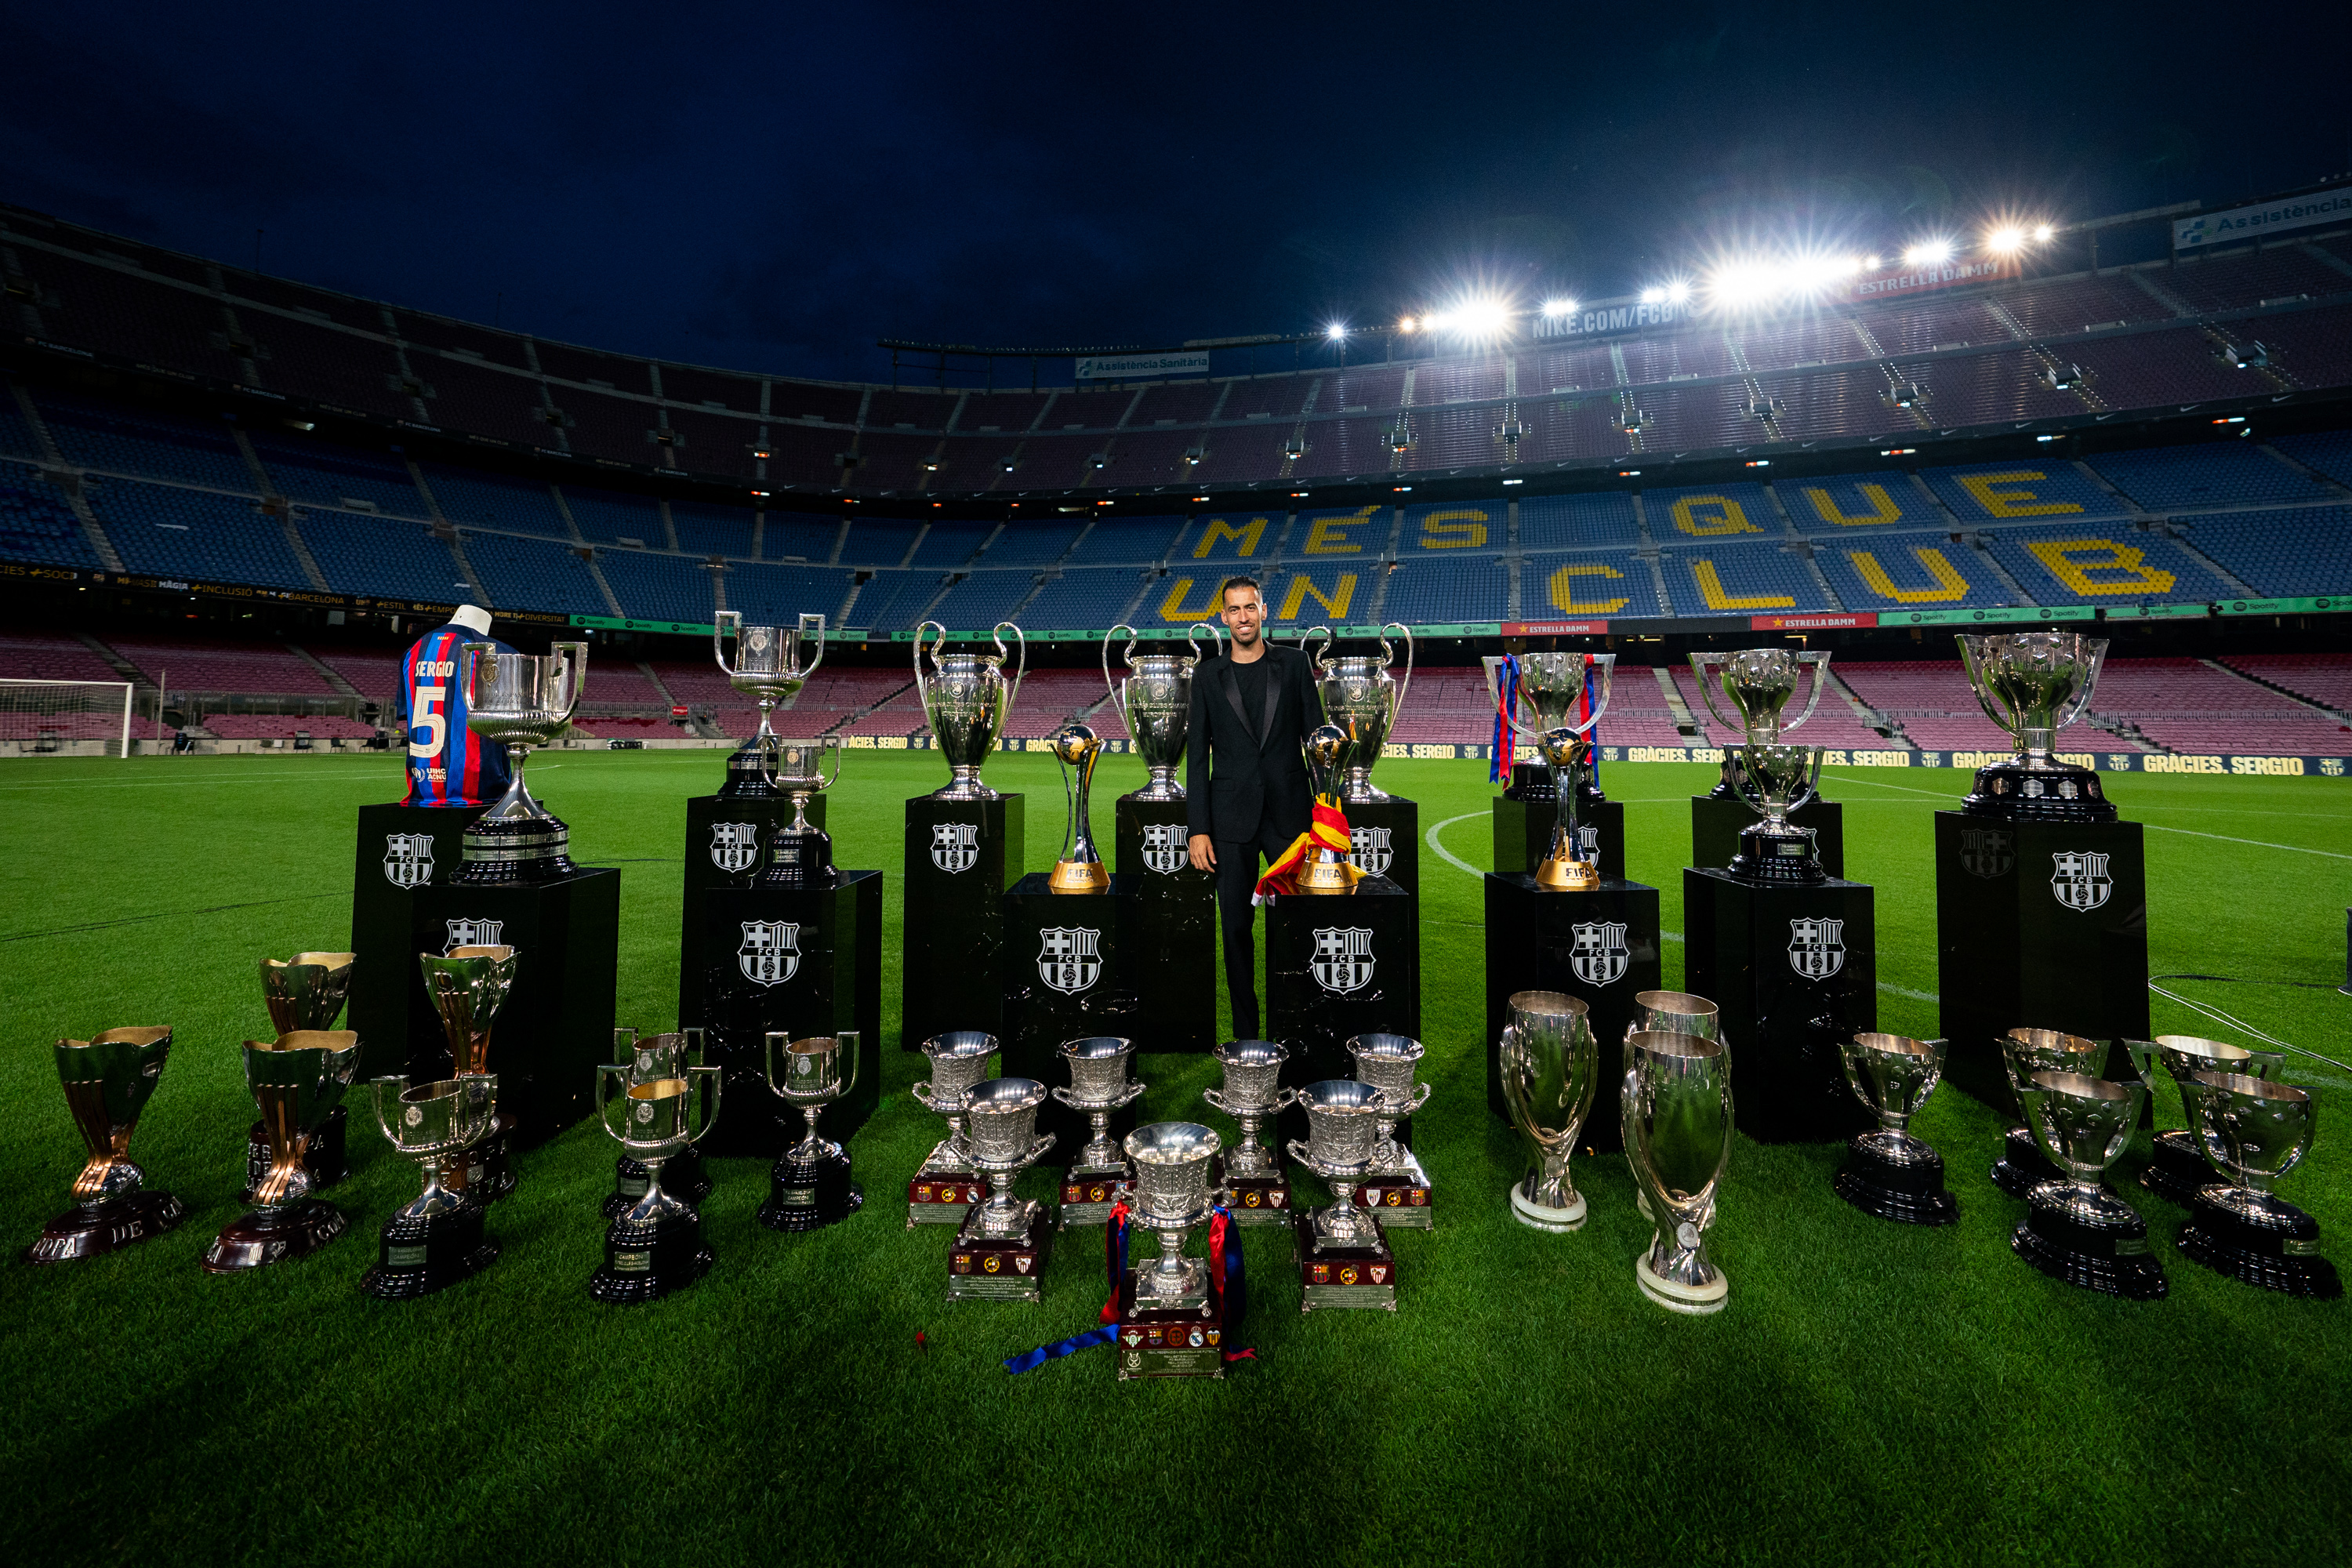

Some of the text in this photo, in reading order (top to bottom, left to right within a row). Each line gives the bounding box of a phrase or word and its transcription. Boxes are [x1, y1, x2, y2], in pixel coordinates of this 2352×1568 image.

[1859, 261, 1998, 295] ESTRELLA DAMM
[1096, 357, 1207, 371] Assistència Sanitària
[1193, 471, 2085, 557] MÉS QUE
[1160, 539, 2177, 622] UN CLUB
[1530, 625, 1564, 633] ESTRELLA
[1785, 617, 1856, 628] ESTRELLA DAMM
[416, 661, 455, 677] SERGIO
[409, 687, 446, 758] 5
[877, 736, 908, 750] SERGIO
[1412, 745, 1455, 760] SERGIO
[1853, 750, 1910, 768] SERGIO
[2231, 756, 2304, 776] SERGIO
[1067, 869, 1093, 878] FIFA
[1315, 868, 1341, 879] FIFA
[1566, 867, 1592, 878] FIFA
[111, 1220, 144, 1244] DE
